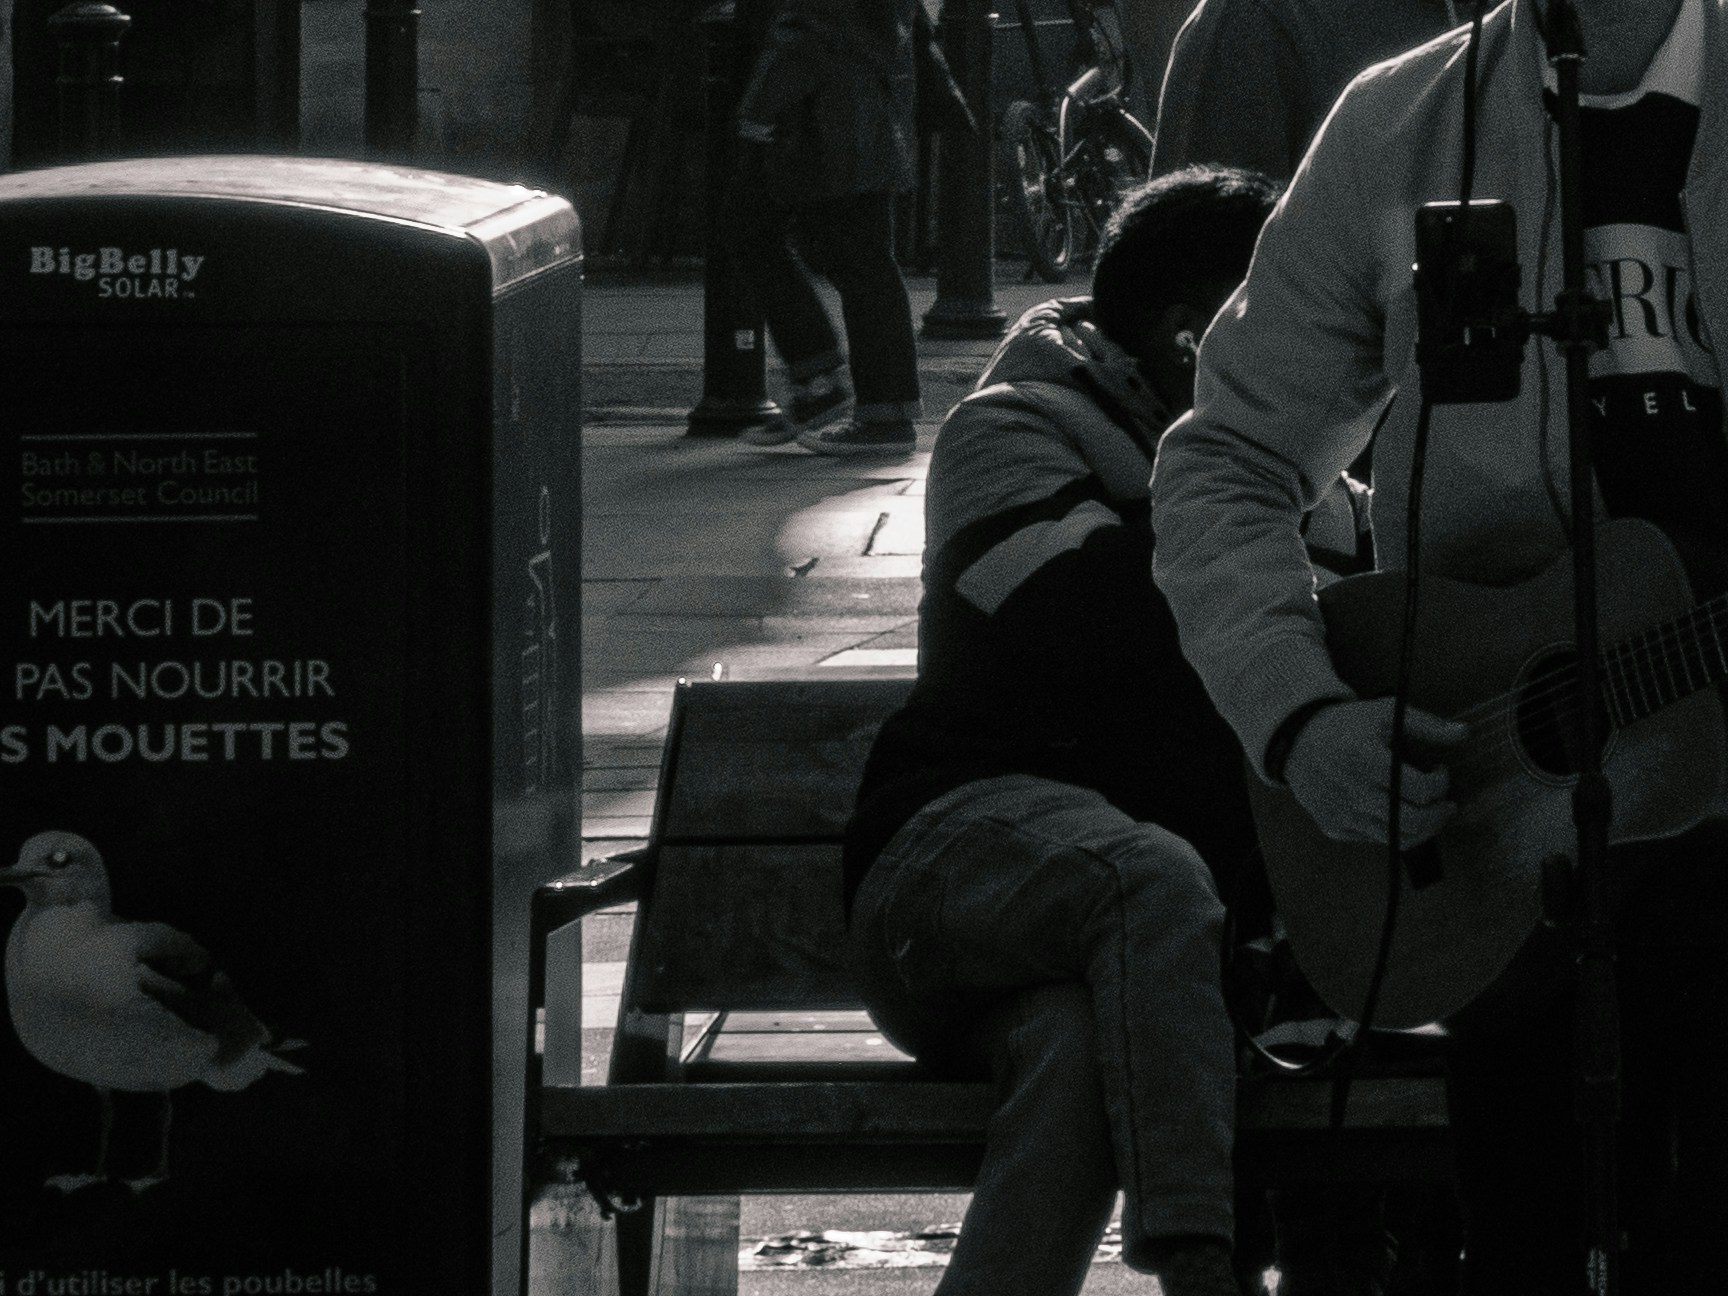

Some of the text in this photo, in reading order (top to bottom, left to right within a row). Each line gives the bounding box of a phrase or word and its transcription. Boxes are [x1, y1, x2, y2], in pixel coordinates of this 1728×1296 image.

[30, 245, 205, 281] BigBelly
[98, 277, 180, 298] SOLAR
[21, 448, 259, 476] Bath & North East
[21, 479, 259, 507] Somerset Council
[29, 597, 254, 638] MERCI DE
[16, 659, 336, 700] PAS NOURRIR
[46, 721, 351, 764] MOUETTES
[168, 1268, 212, 1296] les
[223, 1267, 377, 1296] poubelles
